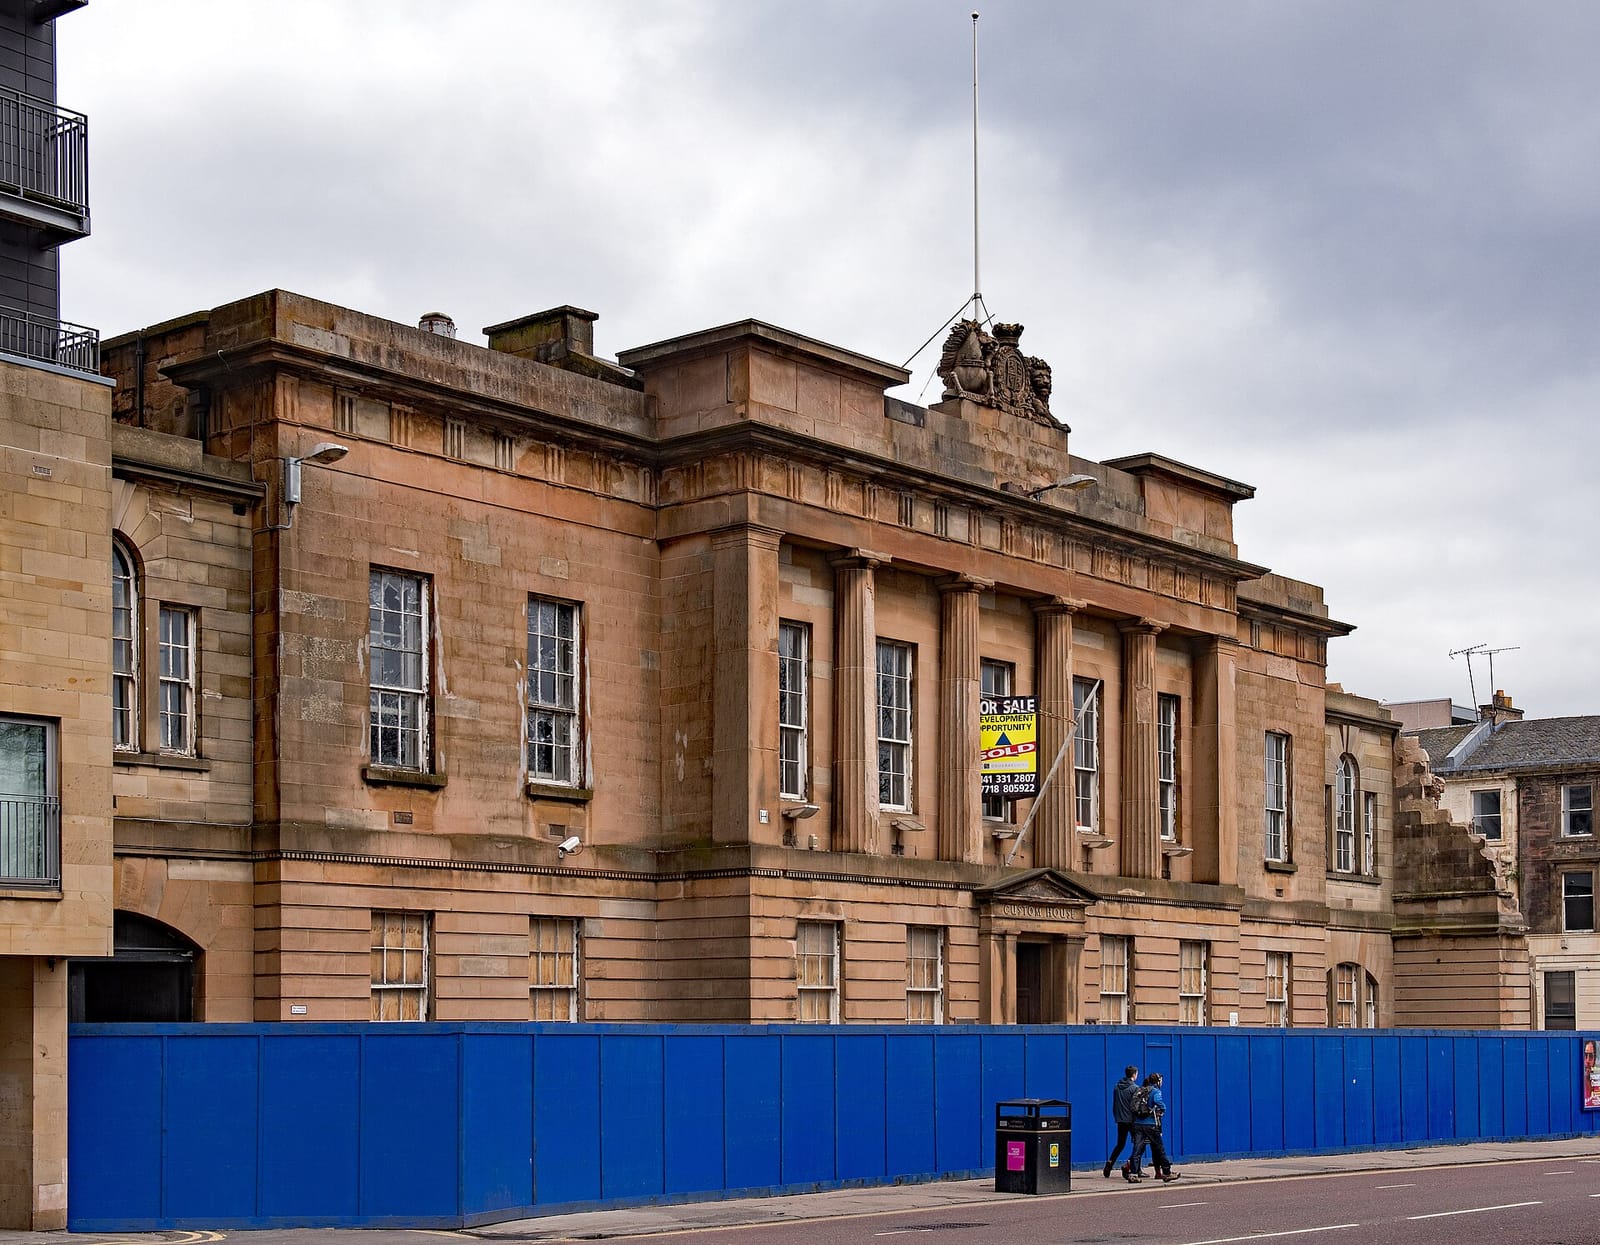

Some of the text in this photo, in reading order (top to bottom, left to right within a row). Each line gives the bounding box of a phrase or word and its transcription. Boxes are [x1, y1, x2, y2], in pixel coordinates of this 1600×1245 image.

[980, 699, 1034, 714] OR SALE
[980, 714, 1034, 723] EVELOPMENT
[980, 724, 1032, 732] PPORTUNITY
[996, 774, 1010, 783] 331
[1014, 774, 1036, 782] 2807
[981, 784, 1034, 794] 7718 805922
[1004, 904, 1075, 919] CUSTOM HOUSE
